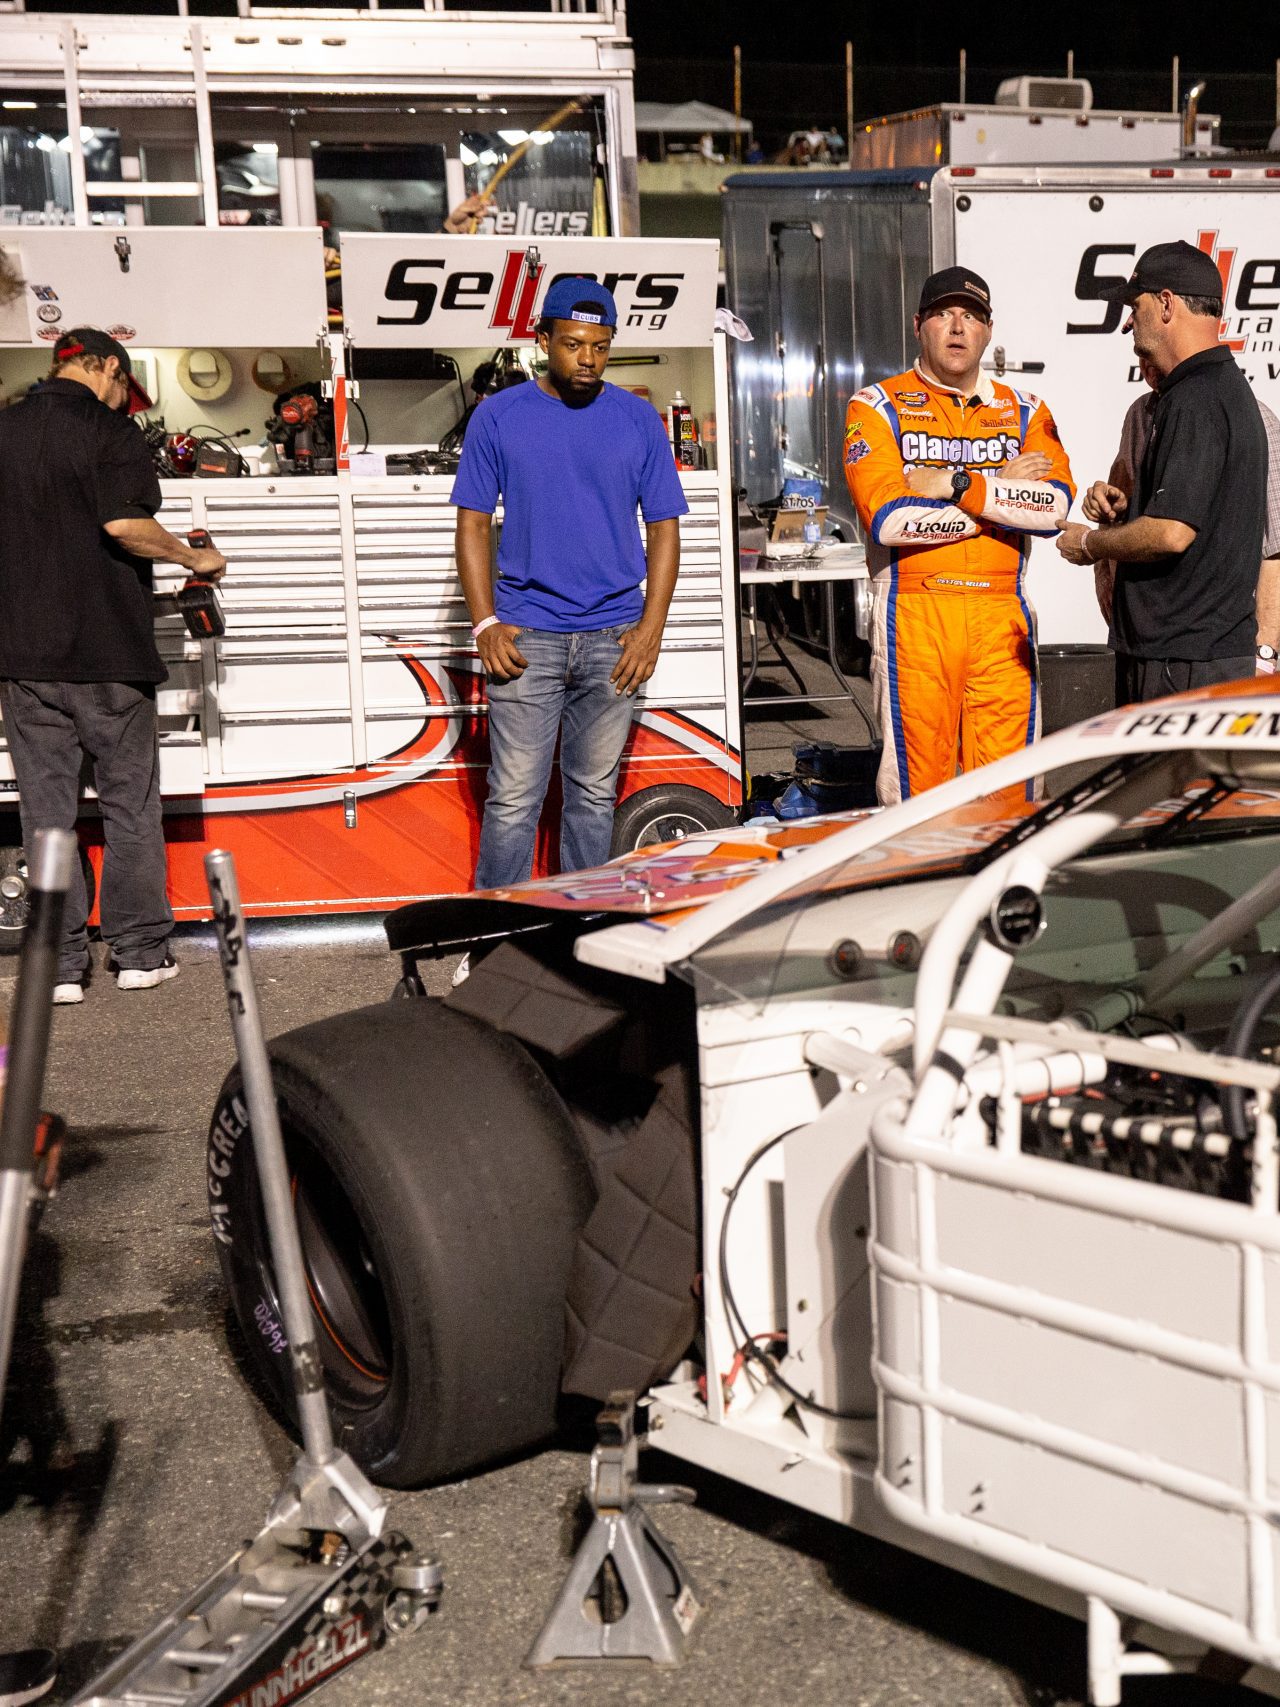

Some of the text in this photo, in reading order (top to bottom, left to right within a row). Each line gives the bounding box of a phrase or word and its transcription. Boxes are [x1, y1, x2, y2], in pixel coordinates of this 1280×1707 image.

[579, 314, 600, 323] CUBS
[898, 414, 938, 422] TOYOTA
[901, 433, 1020, 463] Clarence's
